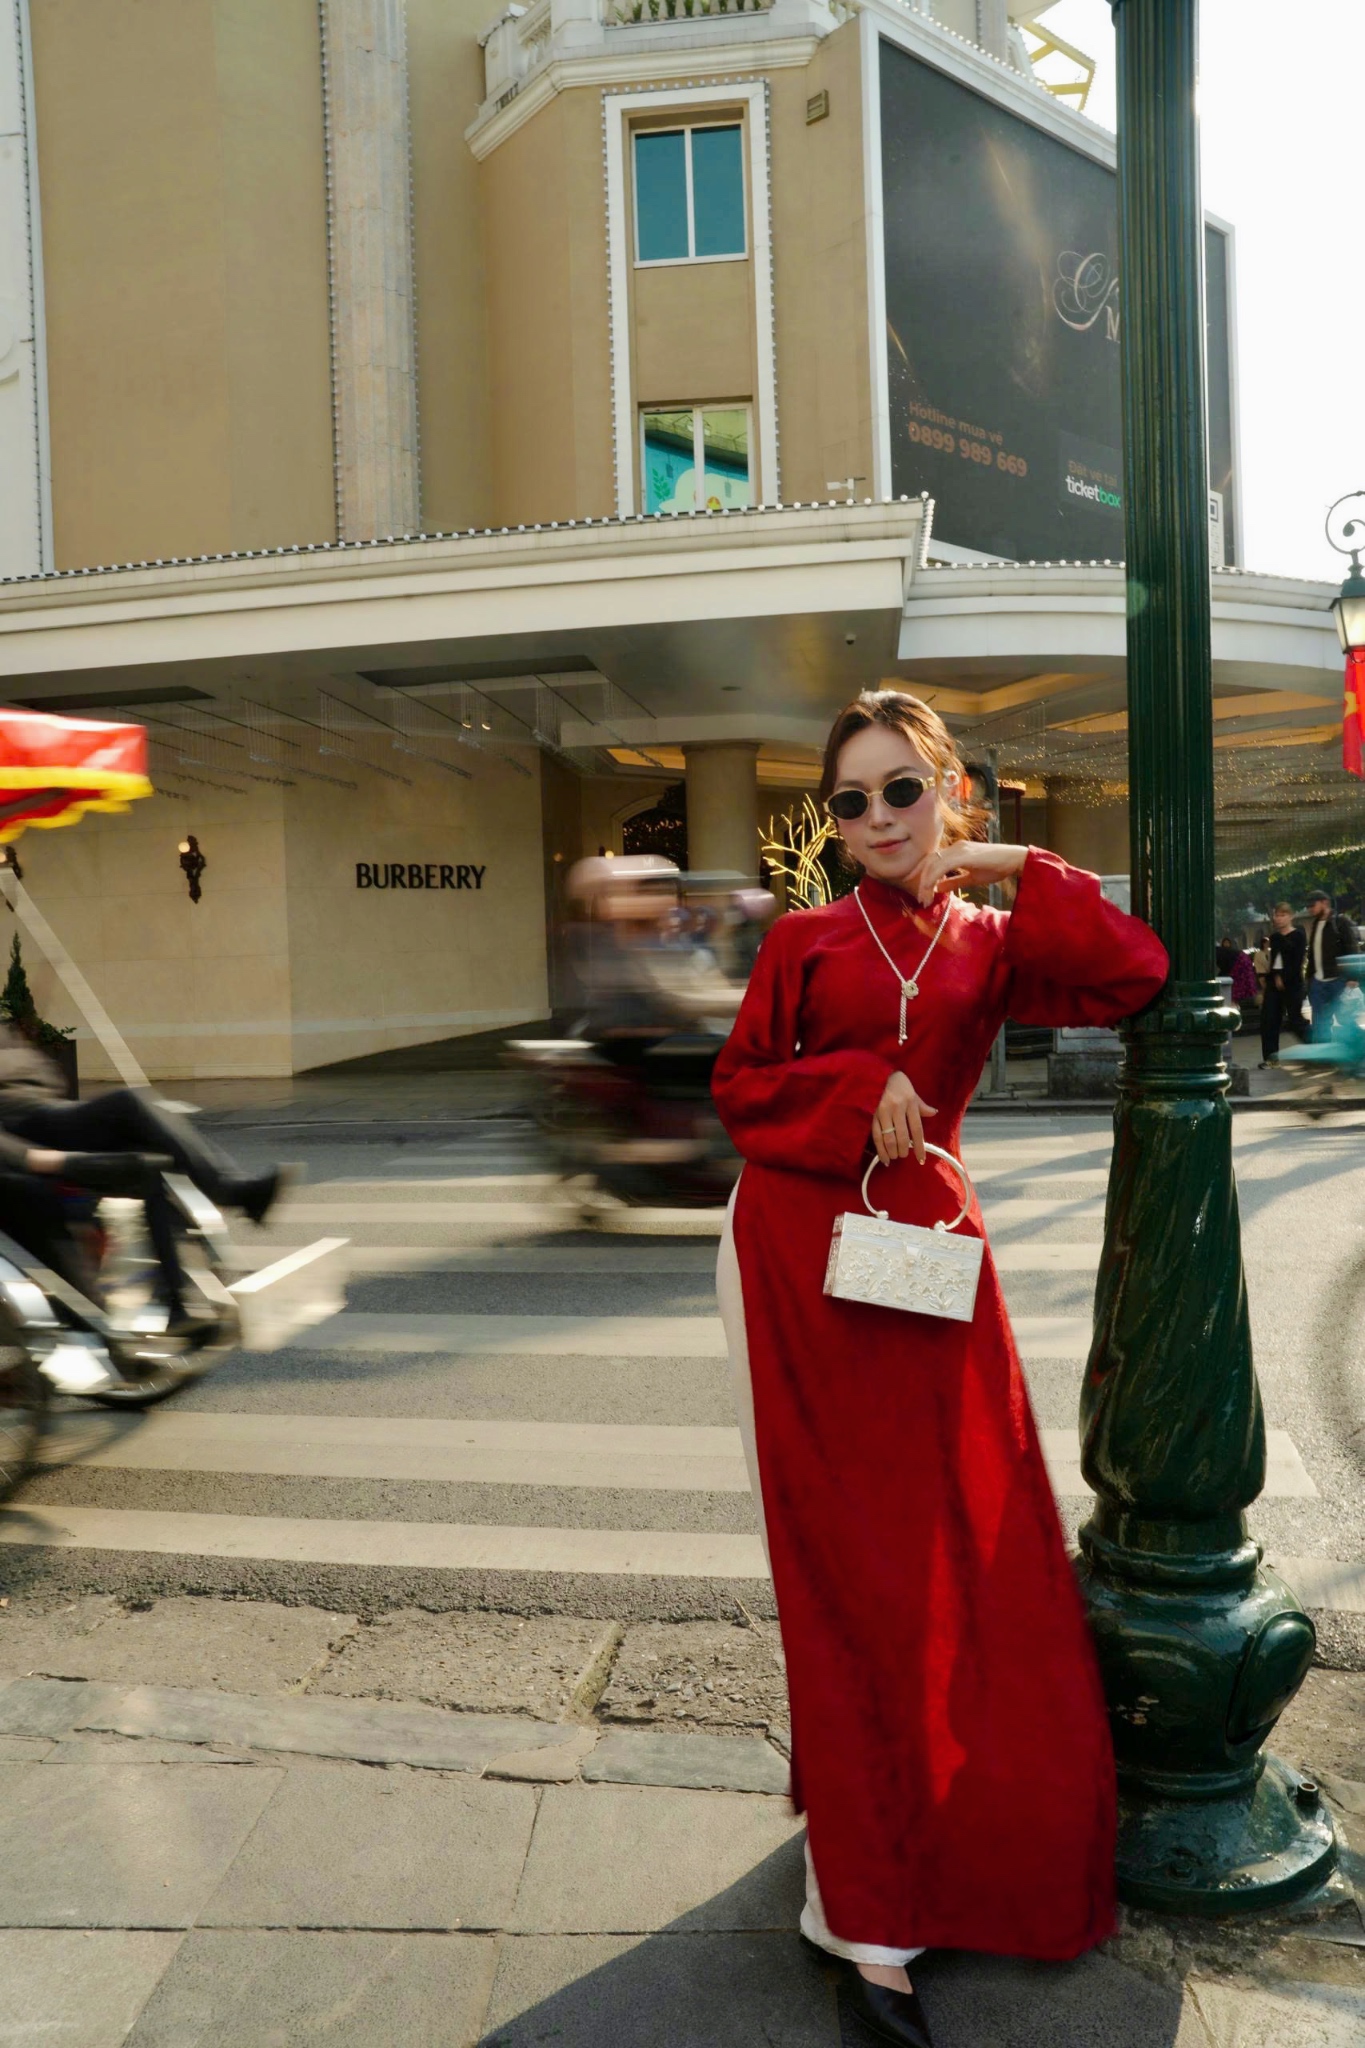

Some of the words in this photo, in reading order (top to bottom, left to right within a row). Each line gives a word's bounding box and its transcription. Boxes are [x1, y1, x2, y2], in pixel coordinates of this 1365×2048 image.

[909, 401, 956, 429] Hotline
[959, 421, 986, 439] mua
[908, 421, 955, 453] 0899
[959, 438, 992, 466] 989
[997, 451, 1028, 478] 669
[1065, 475, 1121, 510] ticketbox
[355, 862, 487, 890] BURBERRY
